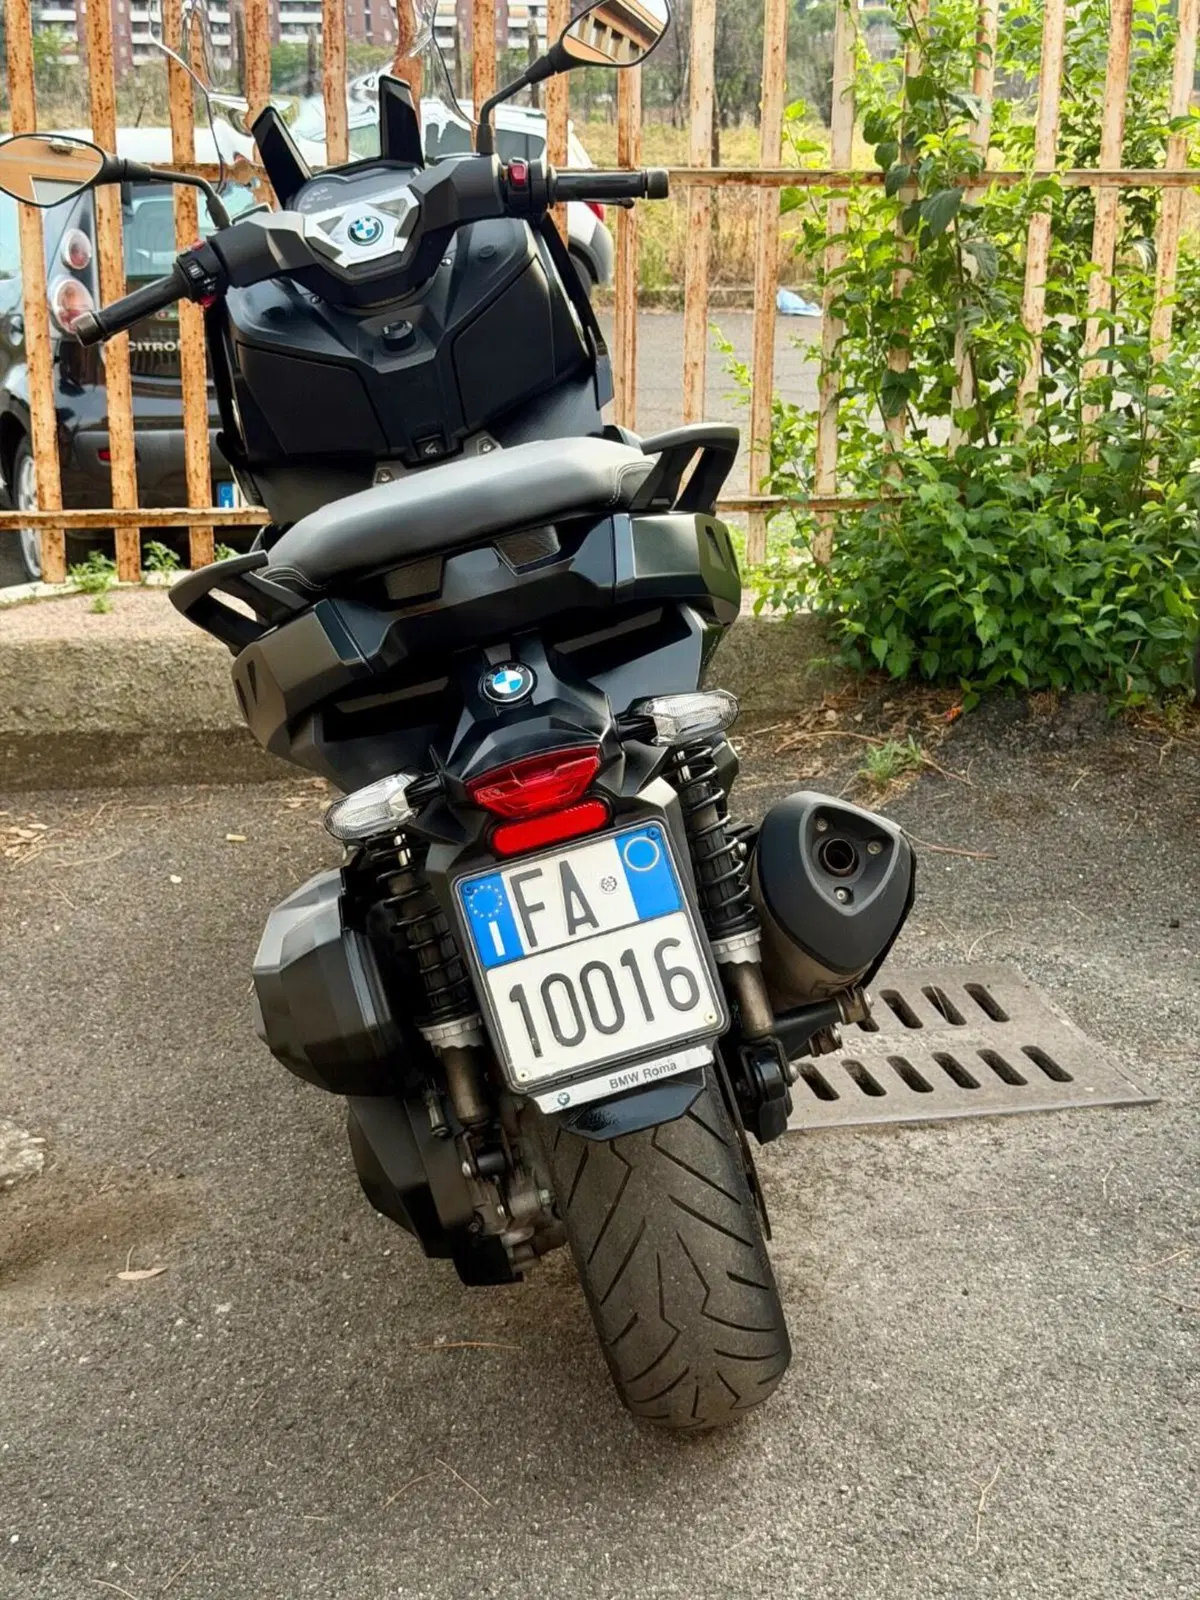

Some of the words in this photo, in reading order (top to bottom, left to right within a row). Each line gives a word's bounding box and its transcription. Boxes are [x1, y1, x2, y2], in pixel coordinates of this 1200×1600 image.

[128, 340, 181, 352] CITRO
[485, 665, 526, 686] BMW
[509, 859, 599, 948] FA
[508, 936, 700, 1058] 10016
[609, 1073, 640, 1090] BMW
[643, 1062, 677, 1081] Roma
